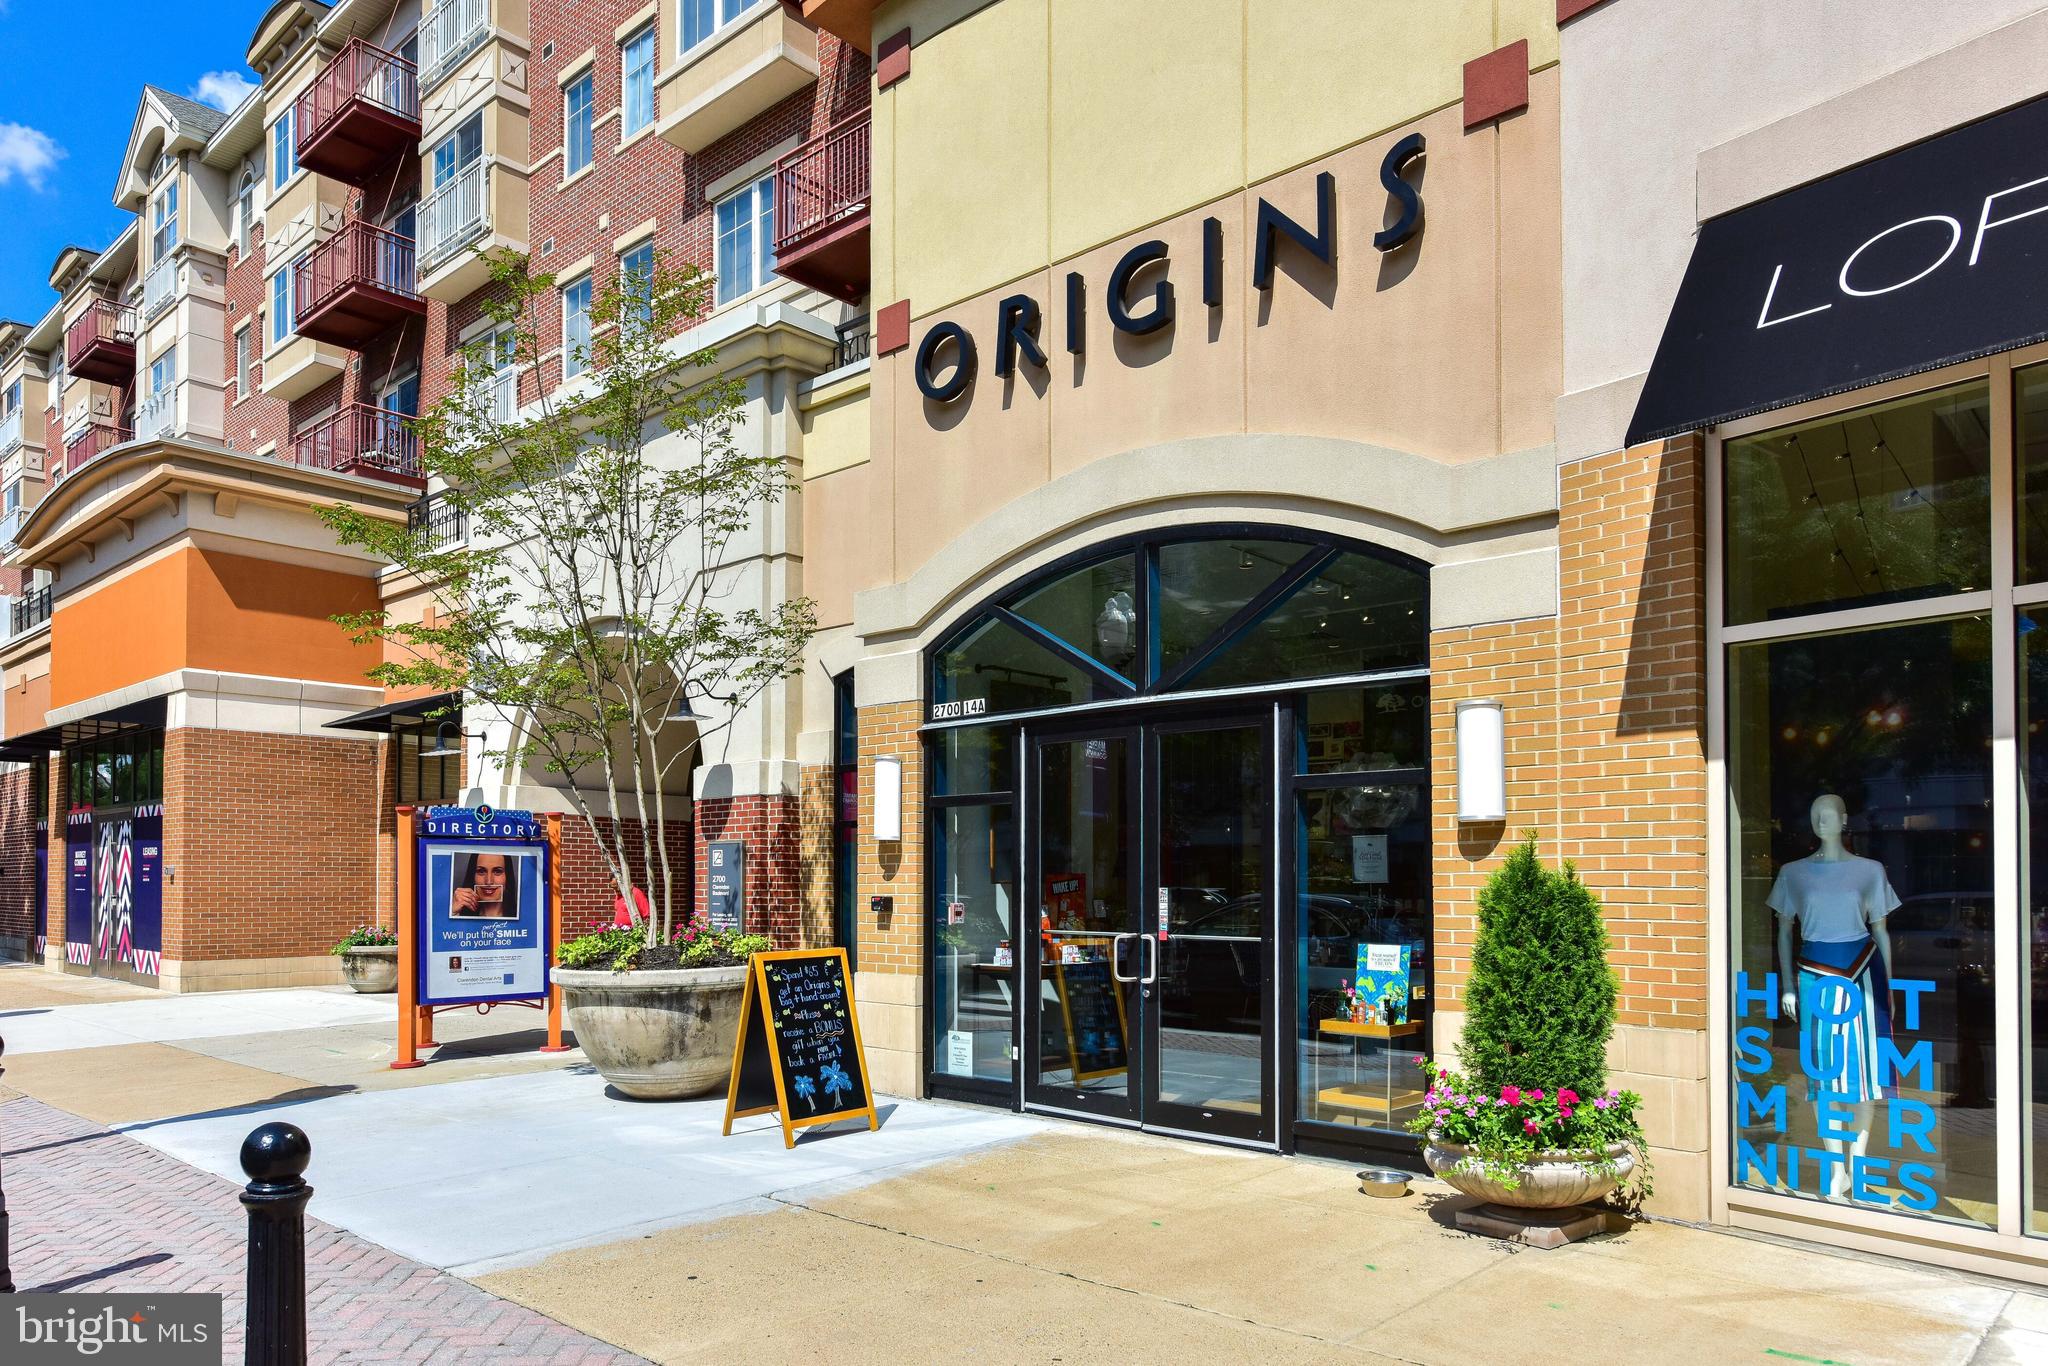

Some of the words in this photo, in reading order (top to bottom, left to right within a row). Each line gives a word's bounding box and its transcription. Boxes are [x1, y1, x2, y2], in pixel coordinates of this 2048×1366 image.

[1757, 176, 2048, 329] LOF
[915, 132, 1427, 402] ORIGINS
[934, 703, 960, 718] 2700
[964, 700, 985, 714] 14A
[428, 822, 537, 836] DIRECTORY
[142, 847, 158, 855] LEASING
[712, 875, 726, 883] 2700
[1052, 881, 1069, 894] WAKE
[1069, 880, 1079, 892] UP!
[442, 931, 464, 940] We'll
[466, 932, 480, 940] put
[481, 930, 494, 938] the
[496, 929, 528, 938] SMILE
[482, 921, 508, 931] perfect
[474, 940, 491, 948] your
[493, 938, 512, 946] face
[781, 966, 803, 982] Spend
[804, 965, 819, 977] $65
[779, 983, 791, 998] get
[803, 979, 831, 994] Origins
[778, 995, 795, 1008] bag
[800, 990, 819, 1002] hand
[1737, 972, 1936, 1031] HOT
[801, 1009, 817, 1020] Plus
[783, 1028, 805, 1037] receive
[814, 1019, 843, 1033] BONUS
[792, 1038, 804, 1054] gift
[806, 1037, 823, 1047] when
[828, 1036, 840, 1045] you
[787, 1055, 806, 1067] book
[1736, 1026, 1933, 1092] SUM
[1738, 1081, 1937, 1154] MER
[1738, 1139, 1940, 1211] NITES
